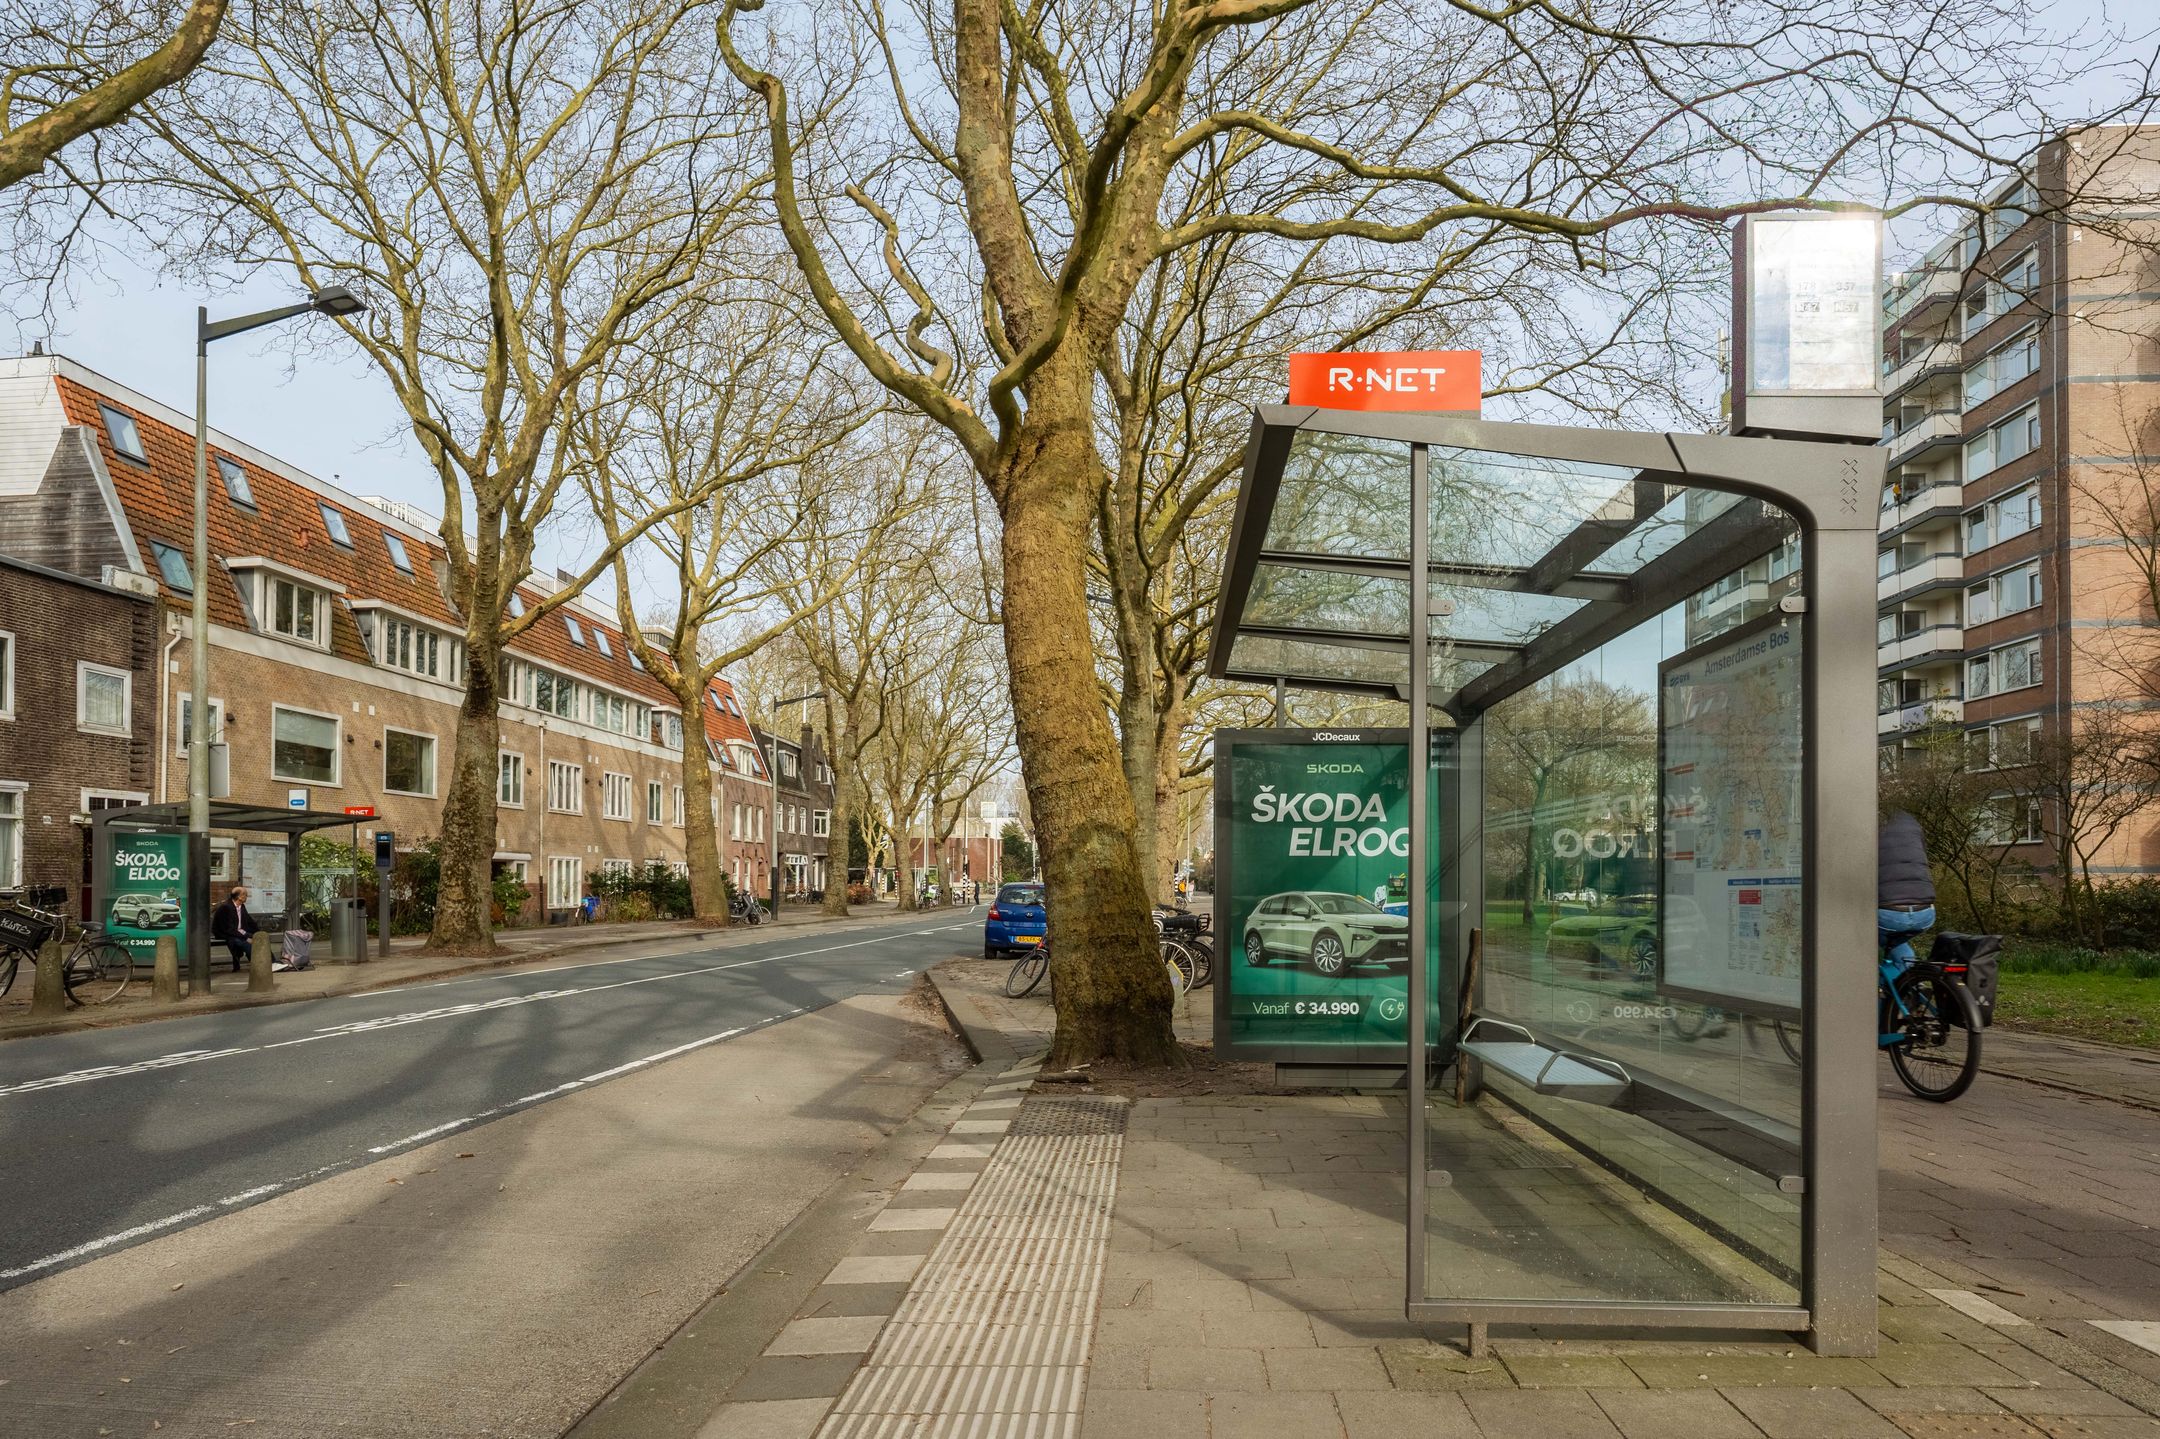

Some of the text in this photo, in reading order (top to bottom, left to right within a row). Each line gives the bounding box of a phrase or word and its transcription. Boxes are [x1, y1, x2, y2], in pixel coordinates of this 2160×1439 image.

[1705, 631, 1790, 677] Amsterdamse Bos
[1312, 732, 1360, 741] JCDecaux
[1251, 785, 1387, 822] ŠKODA
[115, 850, 167, 866] ŠKODA
[129, 867, 180, 880] ELROQ
[1253, 1002, 1360, 1015] Vanaf € 34.990
